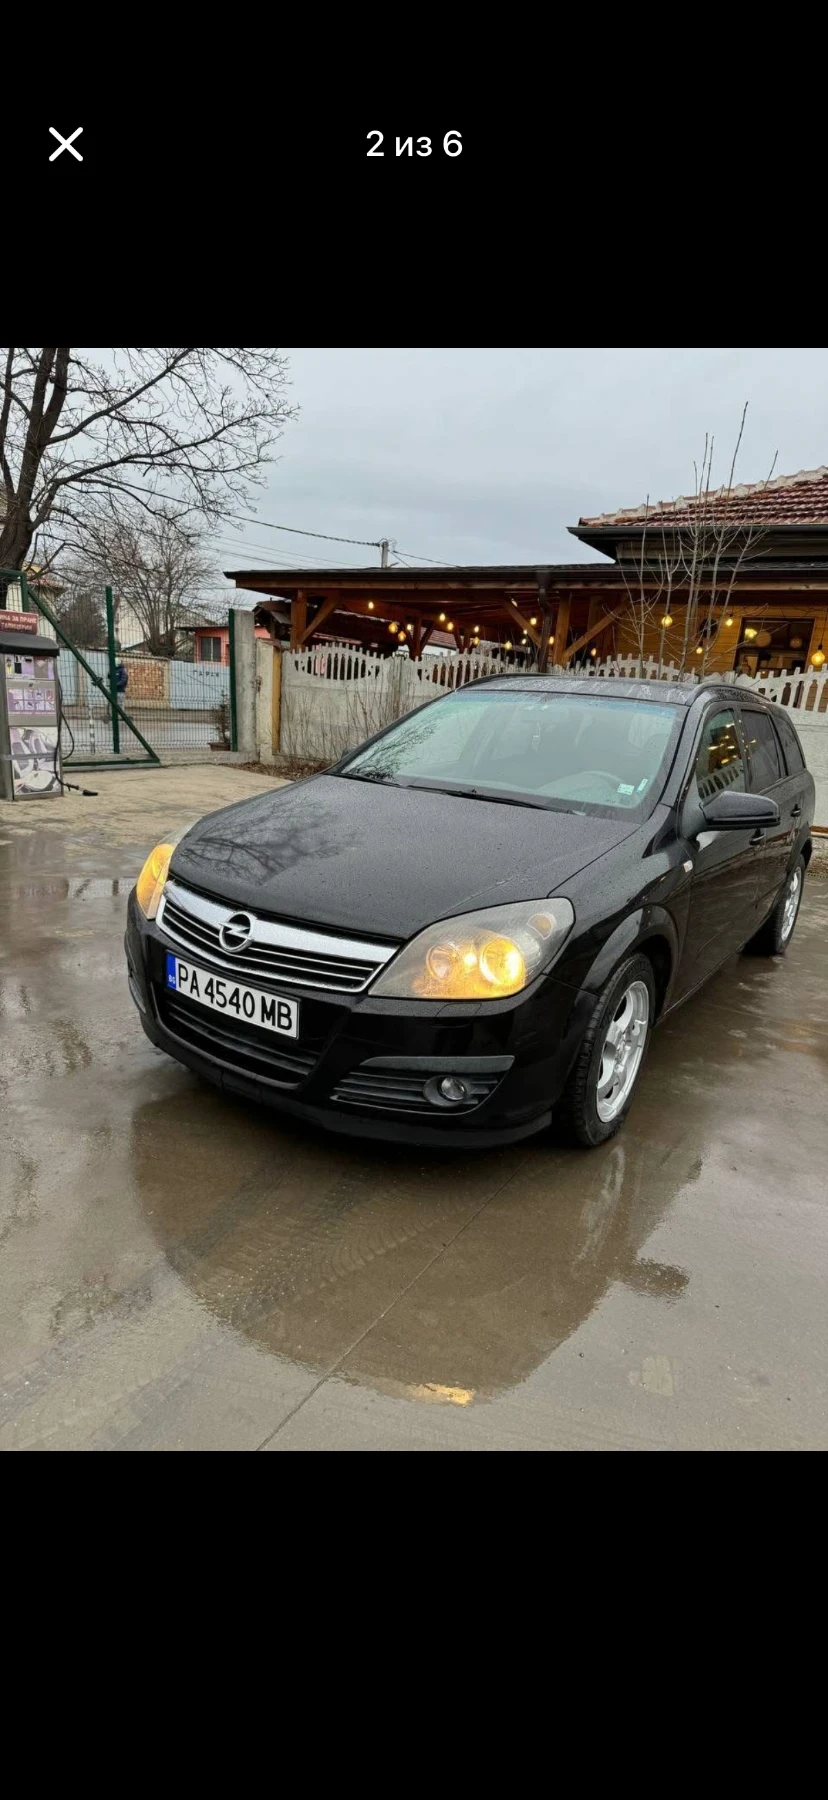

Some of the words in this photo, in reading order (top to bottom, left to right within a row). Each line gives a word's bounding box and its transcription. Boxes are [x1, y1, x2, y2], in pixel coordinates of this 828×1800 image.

[178, 963, 200, 998] PA
[204, 977, 256, 1019] 4540
[261, 995, 293, 1031] MB
